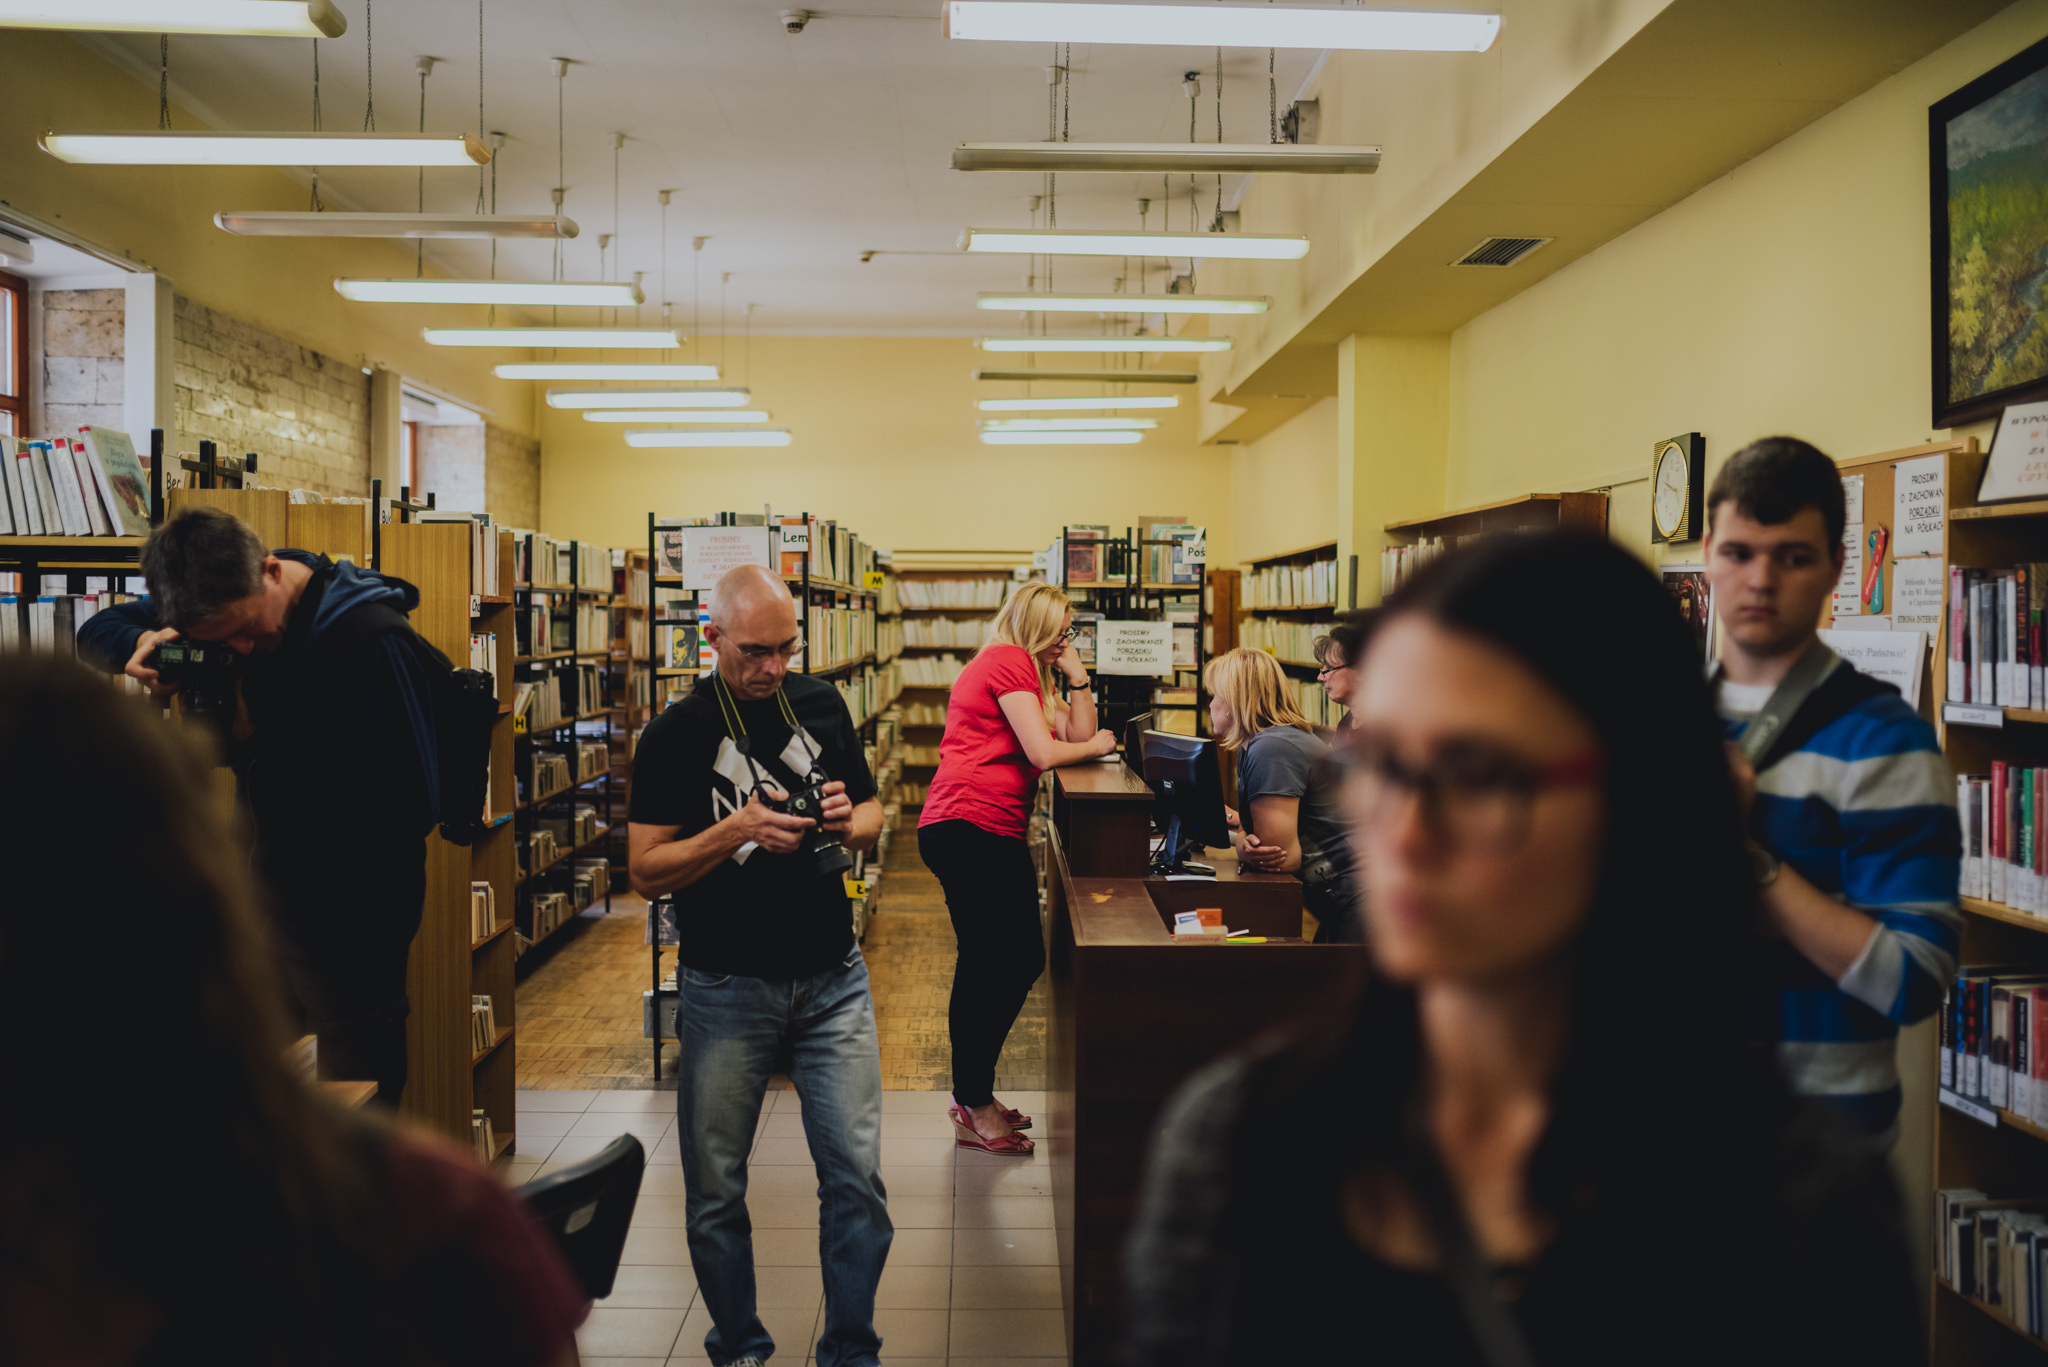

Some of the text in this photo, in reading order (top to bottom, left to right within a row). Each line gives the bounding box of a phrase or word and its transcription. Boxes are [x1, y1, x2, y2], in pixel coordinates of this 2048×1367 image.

[1911, 471, 1939, 485] PROSIMY
[1900, 494, 1905, 504] O
[1909, 506, 1940, 519] PORZĄDKU
[1905, 525, 1914, 535] NA
[783, 531, 808, 543] Lem
[1187, 546, 1206, 558] Poś
[1116, 638, 1164, 646] ZACHOWANIE
[515, 718, 524, 728] H
